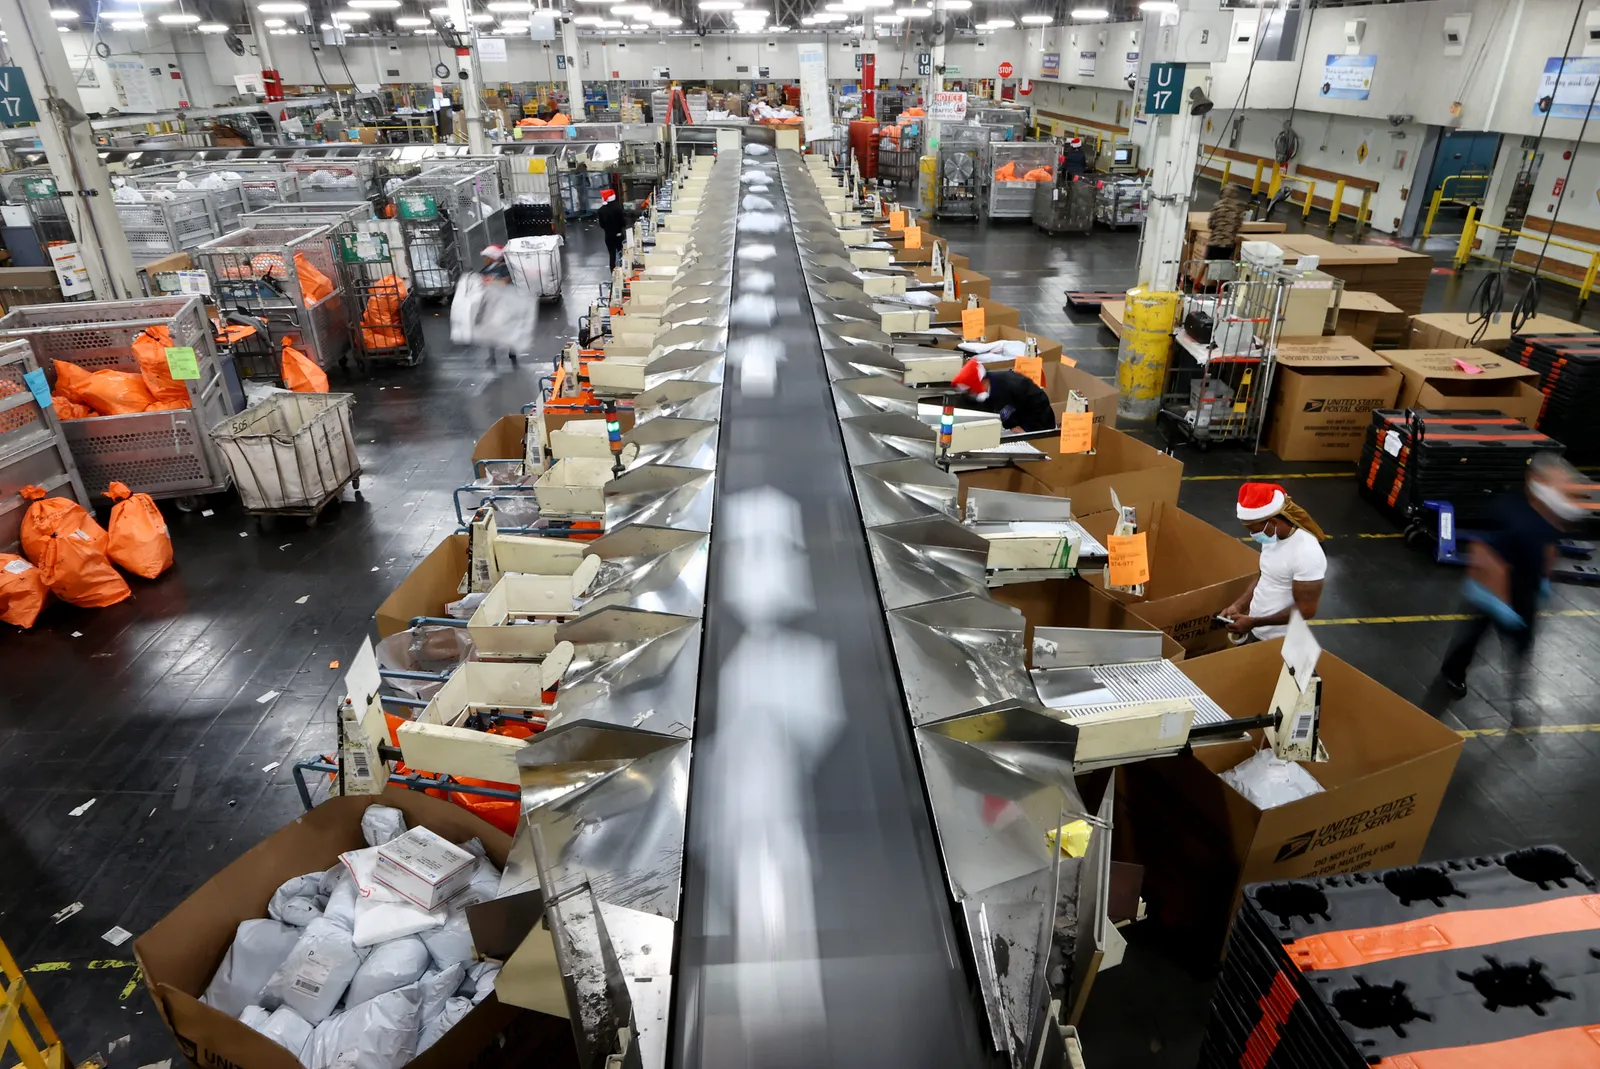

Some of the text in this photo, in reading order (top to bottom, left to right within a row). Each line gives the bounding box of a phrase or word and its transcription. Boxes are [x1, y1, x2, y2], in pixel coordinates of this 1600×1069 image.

[921, 54, 929, 64] U
[920, 66, 930, 74] 18
[1158, 68, 1172, 86] U
[0, 97, 20, 116] 17
[936, 94, 962, 102] NOTICE
[1152, 90, 1172, 110] 17
[1174, 615, 1210, 632] UNITED
[1172, 627, 1206, 642] POSTAL
[1318, 793, 1417, 836] UNITED STATES
[1310, 806, 1416, 851] POSTAL SERVICE
[1314, 842, 1366, 868] DO NOT CUT
[1320, 864, 1336, 876] FOR
[1338, 848, 1378, 868] MULTIPLE
[1380, 840, 1396, 852] USE
